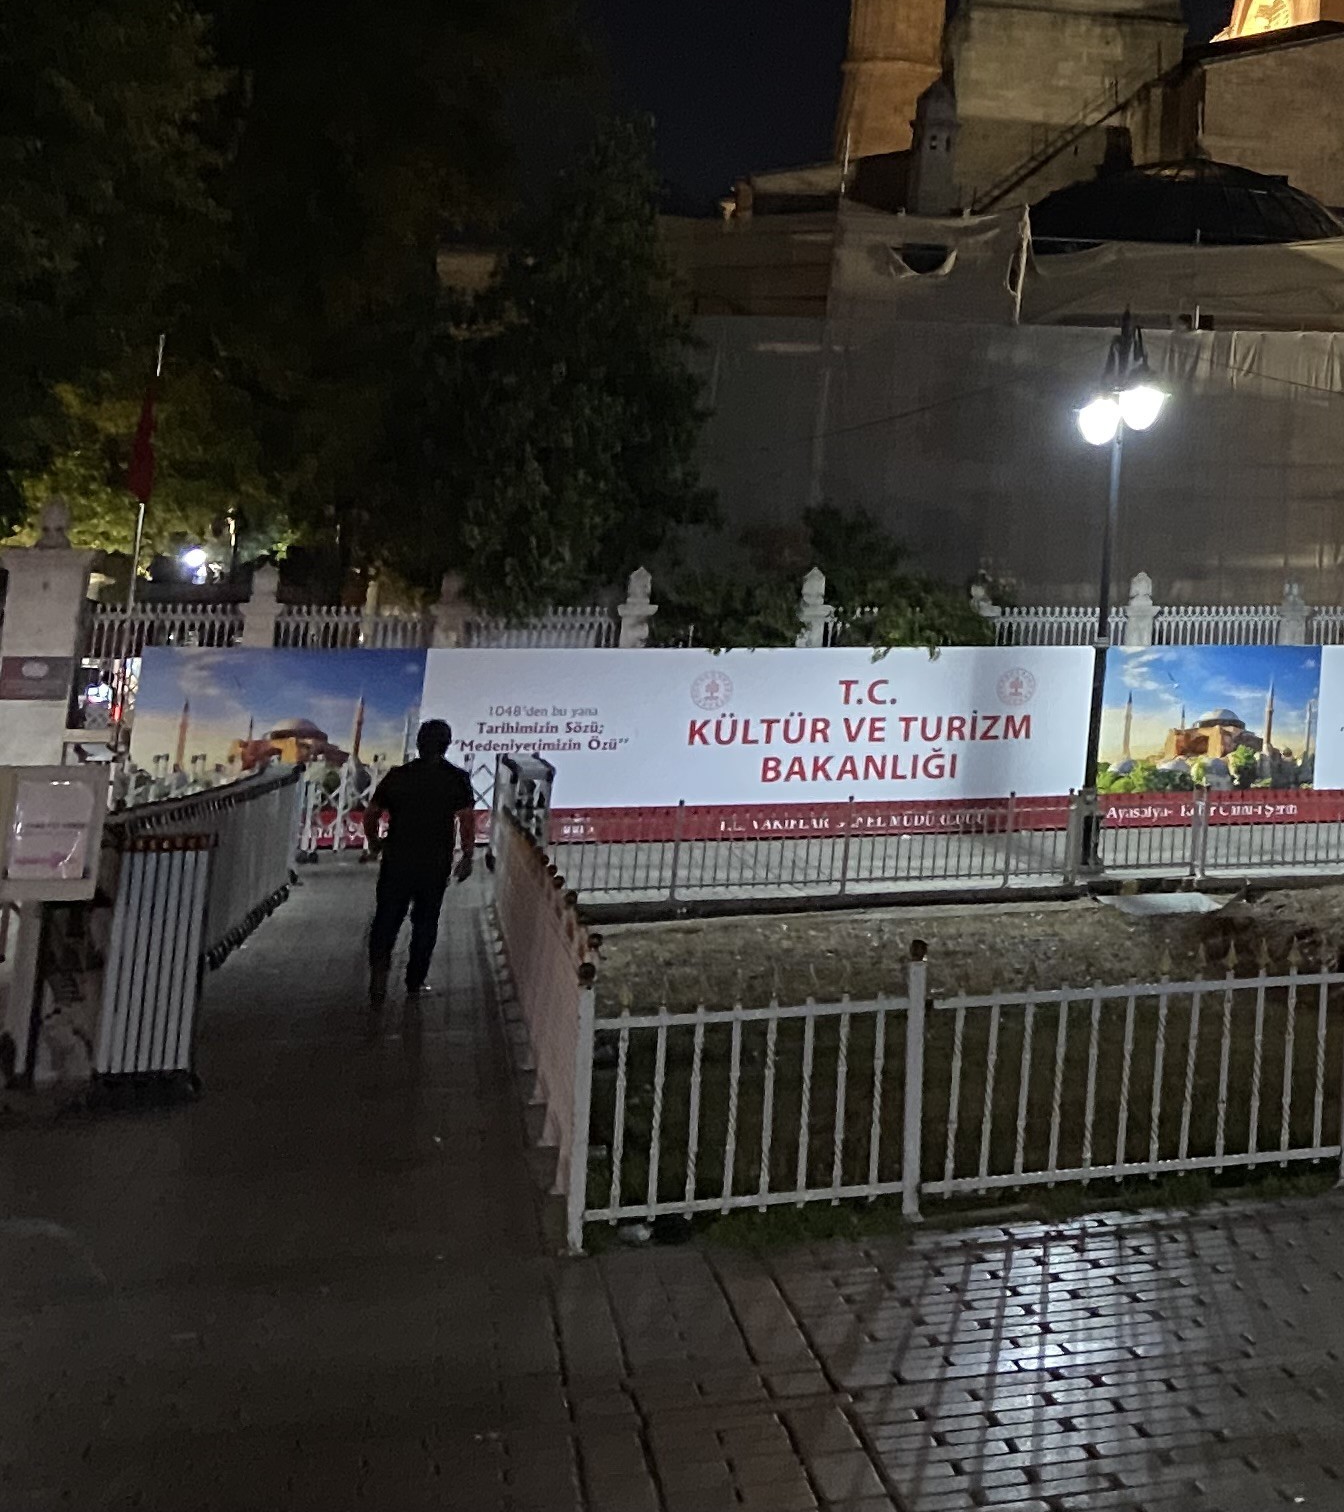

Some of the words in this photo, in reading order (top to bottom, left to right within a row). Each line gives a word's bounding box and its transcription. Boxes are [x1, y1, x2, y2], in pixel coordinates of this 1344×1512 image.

[838, 678, 898, 706] T.C.
[551, 705, 568, 717] bu
[571, 707, 599, 719] yana
[477, 721, 559, 735] Tarihimizin
[687, 711, 831, 746] KÜLTÜR
[843, 715, 887, 744] VE
[898, 709, 1032, 743] TURİZM
[760, 747, 958, 783] BAKANLIĞI
